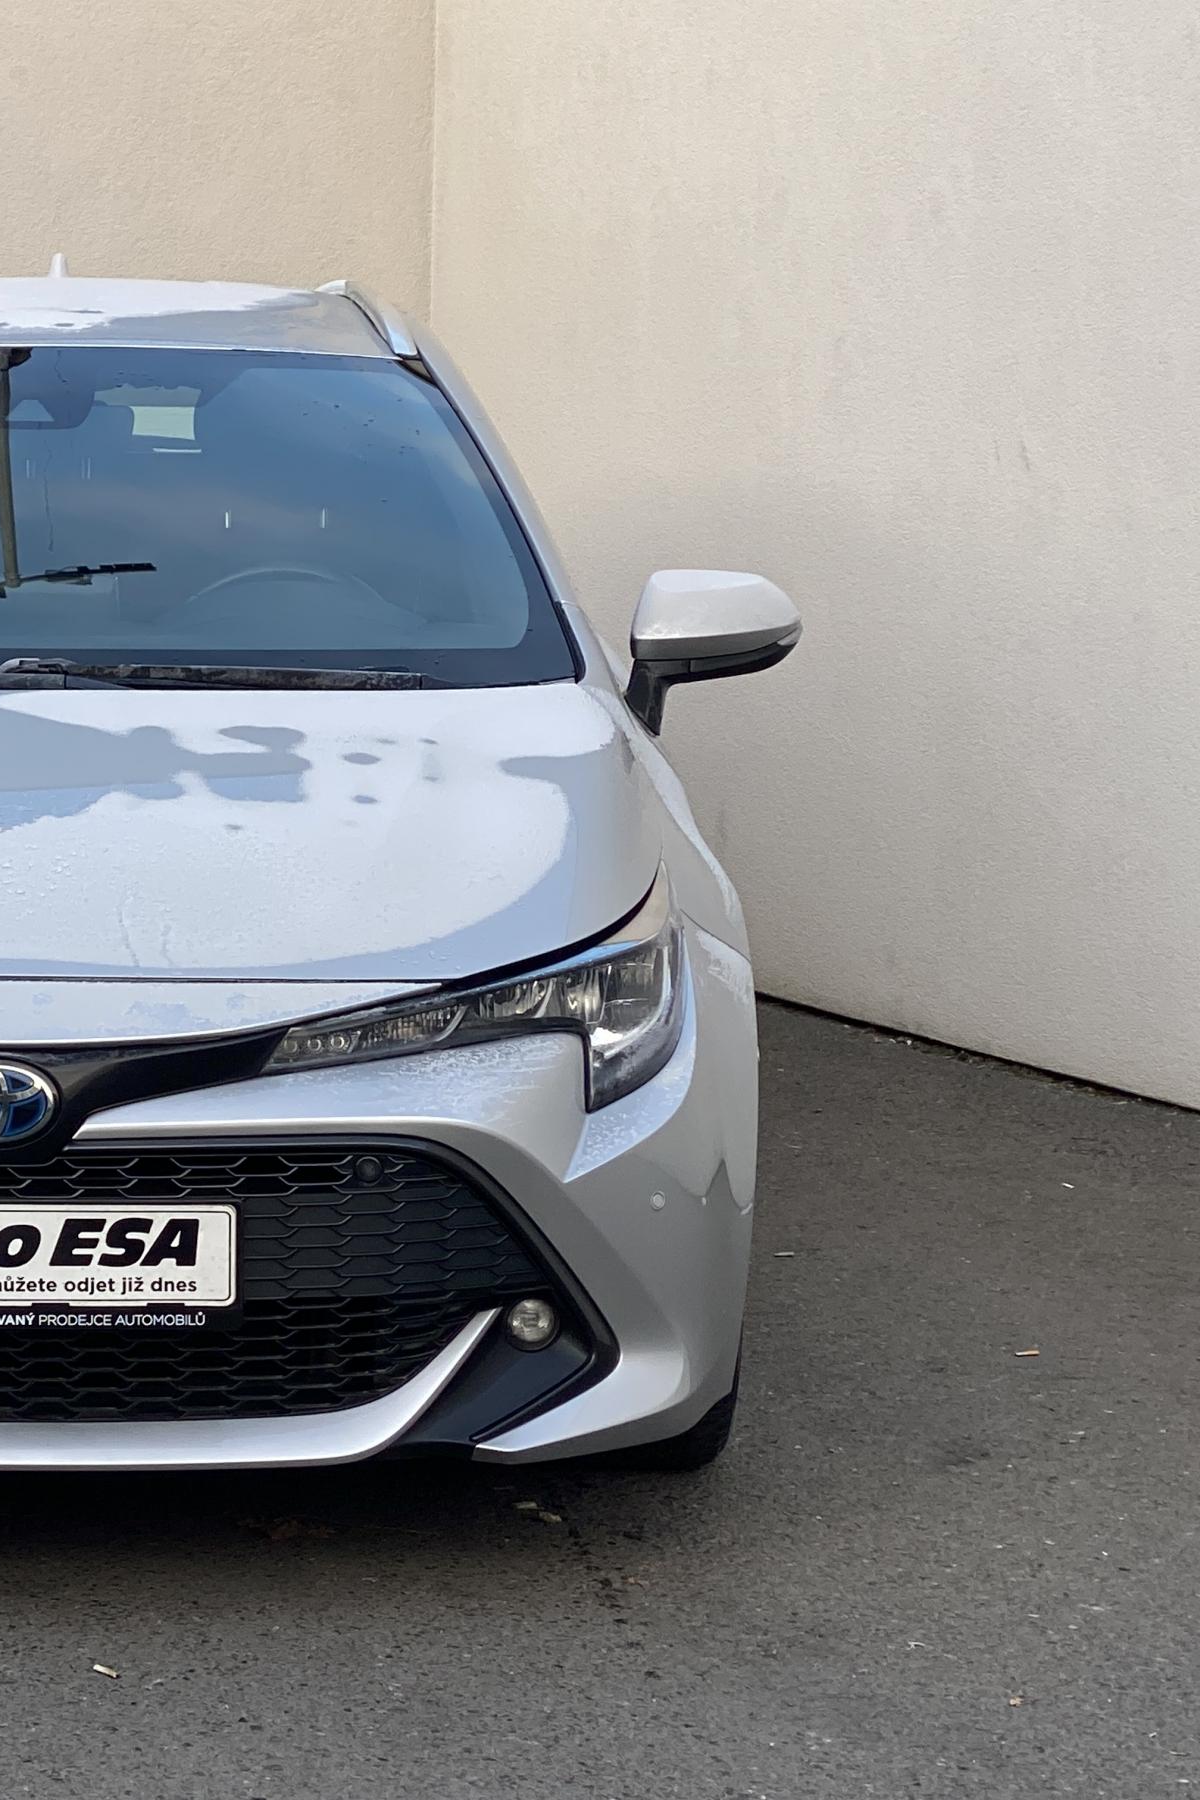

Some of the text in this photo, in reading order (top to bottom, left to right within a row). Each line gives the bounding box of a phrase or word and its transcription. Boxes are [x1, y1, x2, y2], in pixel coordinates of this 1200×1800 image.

[64, 1277, 116, 1296] odjet
[120, 1276, 144, 1296] již
[150, 1276, 197, 1293] dnes
[38, 1313, 113, 1327] PRODEJCE
[114, 1311, 206, 1327] AUTOMOBILŮ
